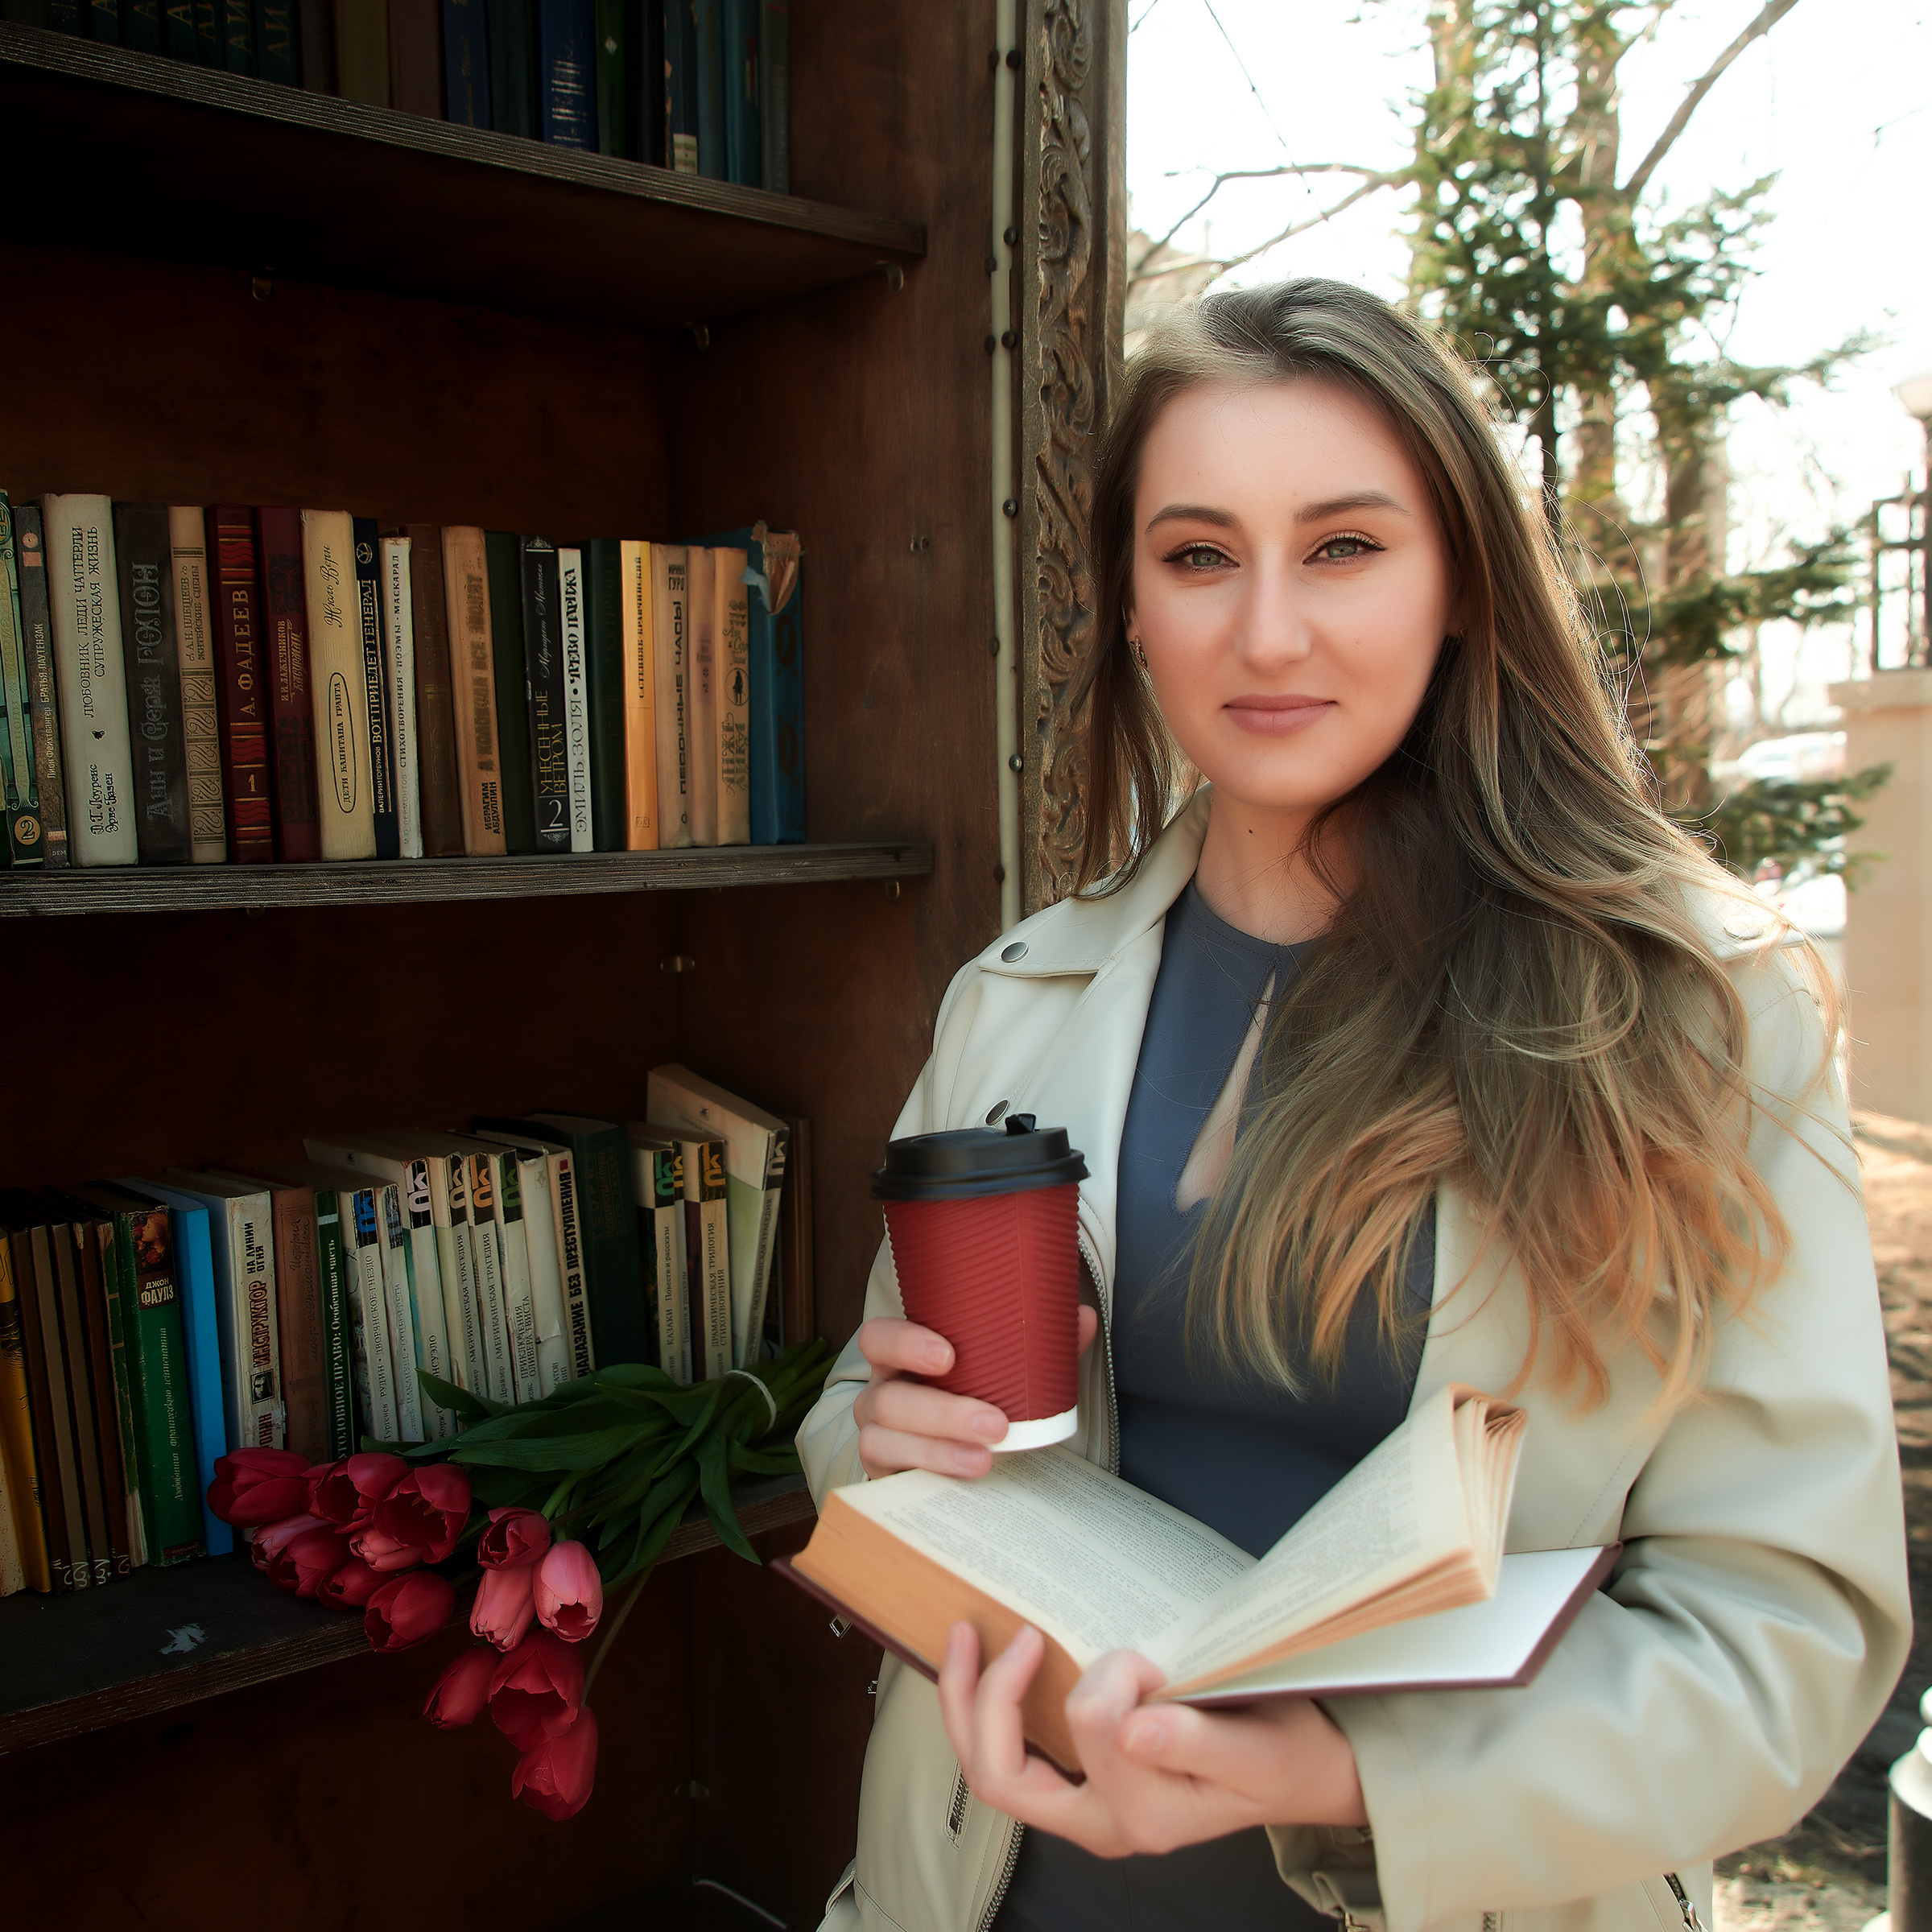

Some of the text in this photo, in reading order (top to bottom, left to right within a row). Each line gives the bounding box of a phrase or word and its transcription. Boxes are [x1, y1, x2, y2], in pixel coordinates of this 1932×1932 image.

[87, 526, 105, 677] СУПРУЖЕСКАЯ ЖИЗНЬ
[180, 577, 194, 629] ПЛЕЩЕЕВ
[192, 565, 205, 660] ЖИТЕЙСКИЕ СЦЕНЫ
[319, 545, 342, 628] Жюль Верн
[361, 579, 375, 644] ГЕНЕРАЛ
[391, 555, 401, 614] МАСКАРАД
[668, 577, 684, 590] ГУРО
[72, 526, 94, 718] ЛЮБОВНИК ЛЕДИ ЧАТТЕРЛИ
[232, 589, 255, 716] А. ФАДЕЕВ
[394, 625, 402, 667] ПОЭМЫ
[538, 620, 552, 678] Маргарет
[34, 622, 56, 778] Лион Фейхтвангер БРАТЬЯ ЛАУТЕНЗАК
[132, 561, 174, 824] Анн и Серж ГОЛОН
[365, 647, 380, 714] ПРИЕДЕТ
[565, 568, 588, 832] ЭМИЛЬ ЗОЛЯ ЧРЕВО ПАРИЖА
[673, 601, 687, 795] ПЕСОЧНЫЕ ЧАСЫ
[332, 682, 351, 803] ДЕТИ КАПИТАНА ГРАНТА
[397, 677, 407, 768] СТИХОТВОРЕНИЯ
[535, 690, 554, 794] УНЕСЕННЫЕ
[89, 764, 102, 809] Лоуренс
[248, 774, 257, 792] 1
[551, 723, 567, 793] ВЕТРОМ
[20, 819, 35, 840] 2
[105, 806, 119, 833] Эрве
[481, 782, 492, 830] ИБРАГИМ
[489, 782, 500, 834] АБДУЛЛИН
[549, 799, 564, 827] 2
[244, 1222, 256, 1275] НА ЛИНИИ
[255, 1245, 265, 1272] ОГНЯ
[289, 1219, 303, 1271] История
[482, 1232, 494, 1282] ТРАГЕДИЯ
[559, 1171, 589, 1378] НАКАЗАНИЕ БЕЗ ПРЕСТУПЛЕНИЯ
[663, 1226, 671, 1261] рассказы
[753, 1244, 767, 1311] АМЕРИКАНСКАЯ
[762, 1197, 773, 1241] ТРАГЕДИЯ
[140, 1285, 174, 1305] ФАУЛЗ
[146, 1278, 169, 1290] ДЖОН
[301, 1217, 320, 1360] моего современника
[456, 1234, 482, 1396] райзер АМЕРИКАНСКАЯ ТРАГЕДИЯ
[522, 1295, 532, 1333] ТВИСТА
[664, 1269, 672, 1301] Повести
[707, 1223, 720, 1347] ДРАМАТИЧЕСКАЯ ТРИЛОГИЯ
[717, 1269, 727, 1346] СТИХОТВОРЕНИЯ
[248, 1280, 270, 1368] ИНСТРУКТОР
[327, 1239, 347, 1459] УГОЛОВНОЕ ПРАВО: Особенная часть
[365, 1255, 393, 1441] Тургенев РУДИН ДВОРЯНСКОЕ ГНЕЗДО
[488, 1283, 503, 1360] АМЕРИКАНСКАЯ
[514, 1305, 529, 1379] ПРИКЛЮЧЕНИЯ
[666, 1309, 675, 1345] КАЗАКИ
[681, 1311, 690, 1343] Повести
[498, 1365, 510, 1401] Драйзер
[668, 1356, 676, 1382] олстой
[438, 1414, 448, 1440] Жорж
